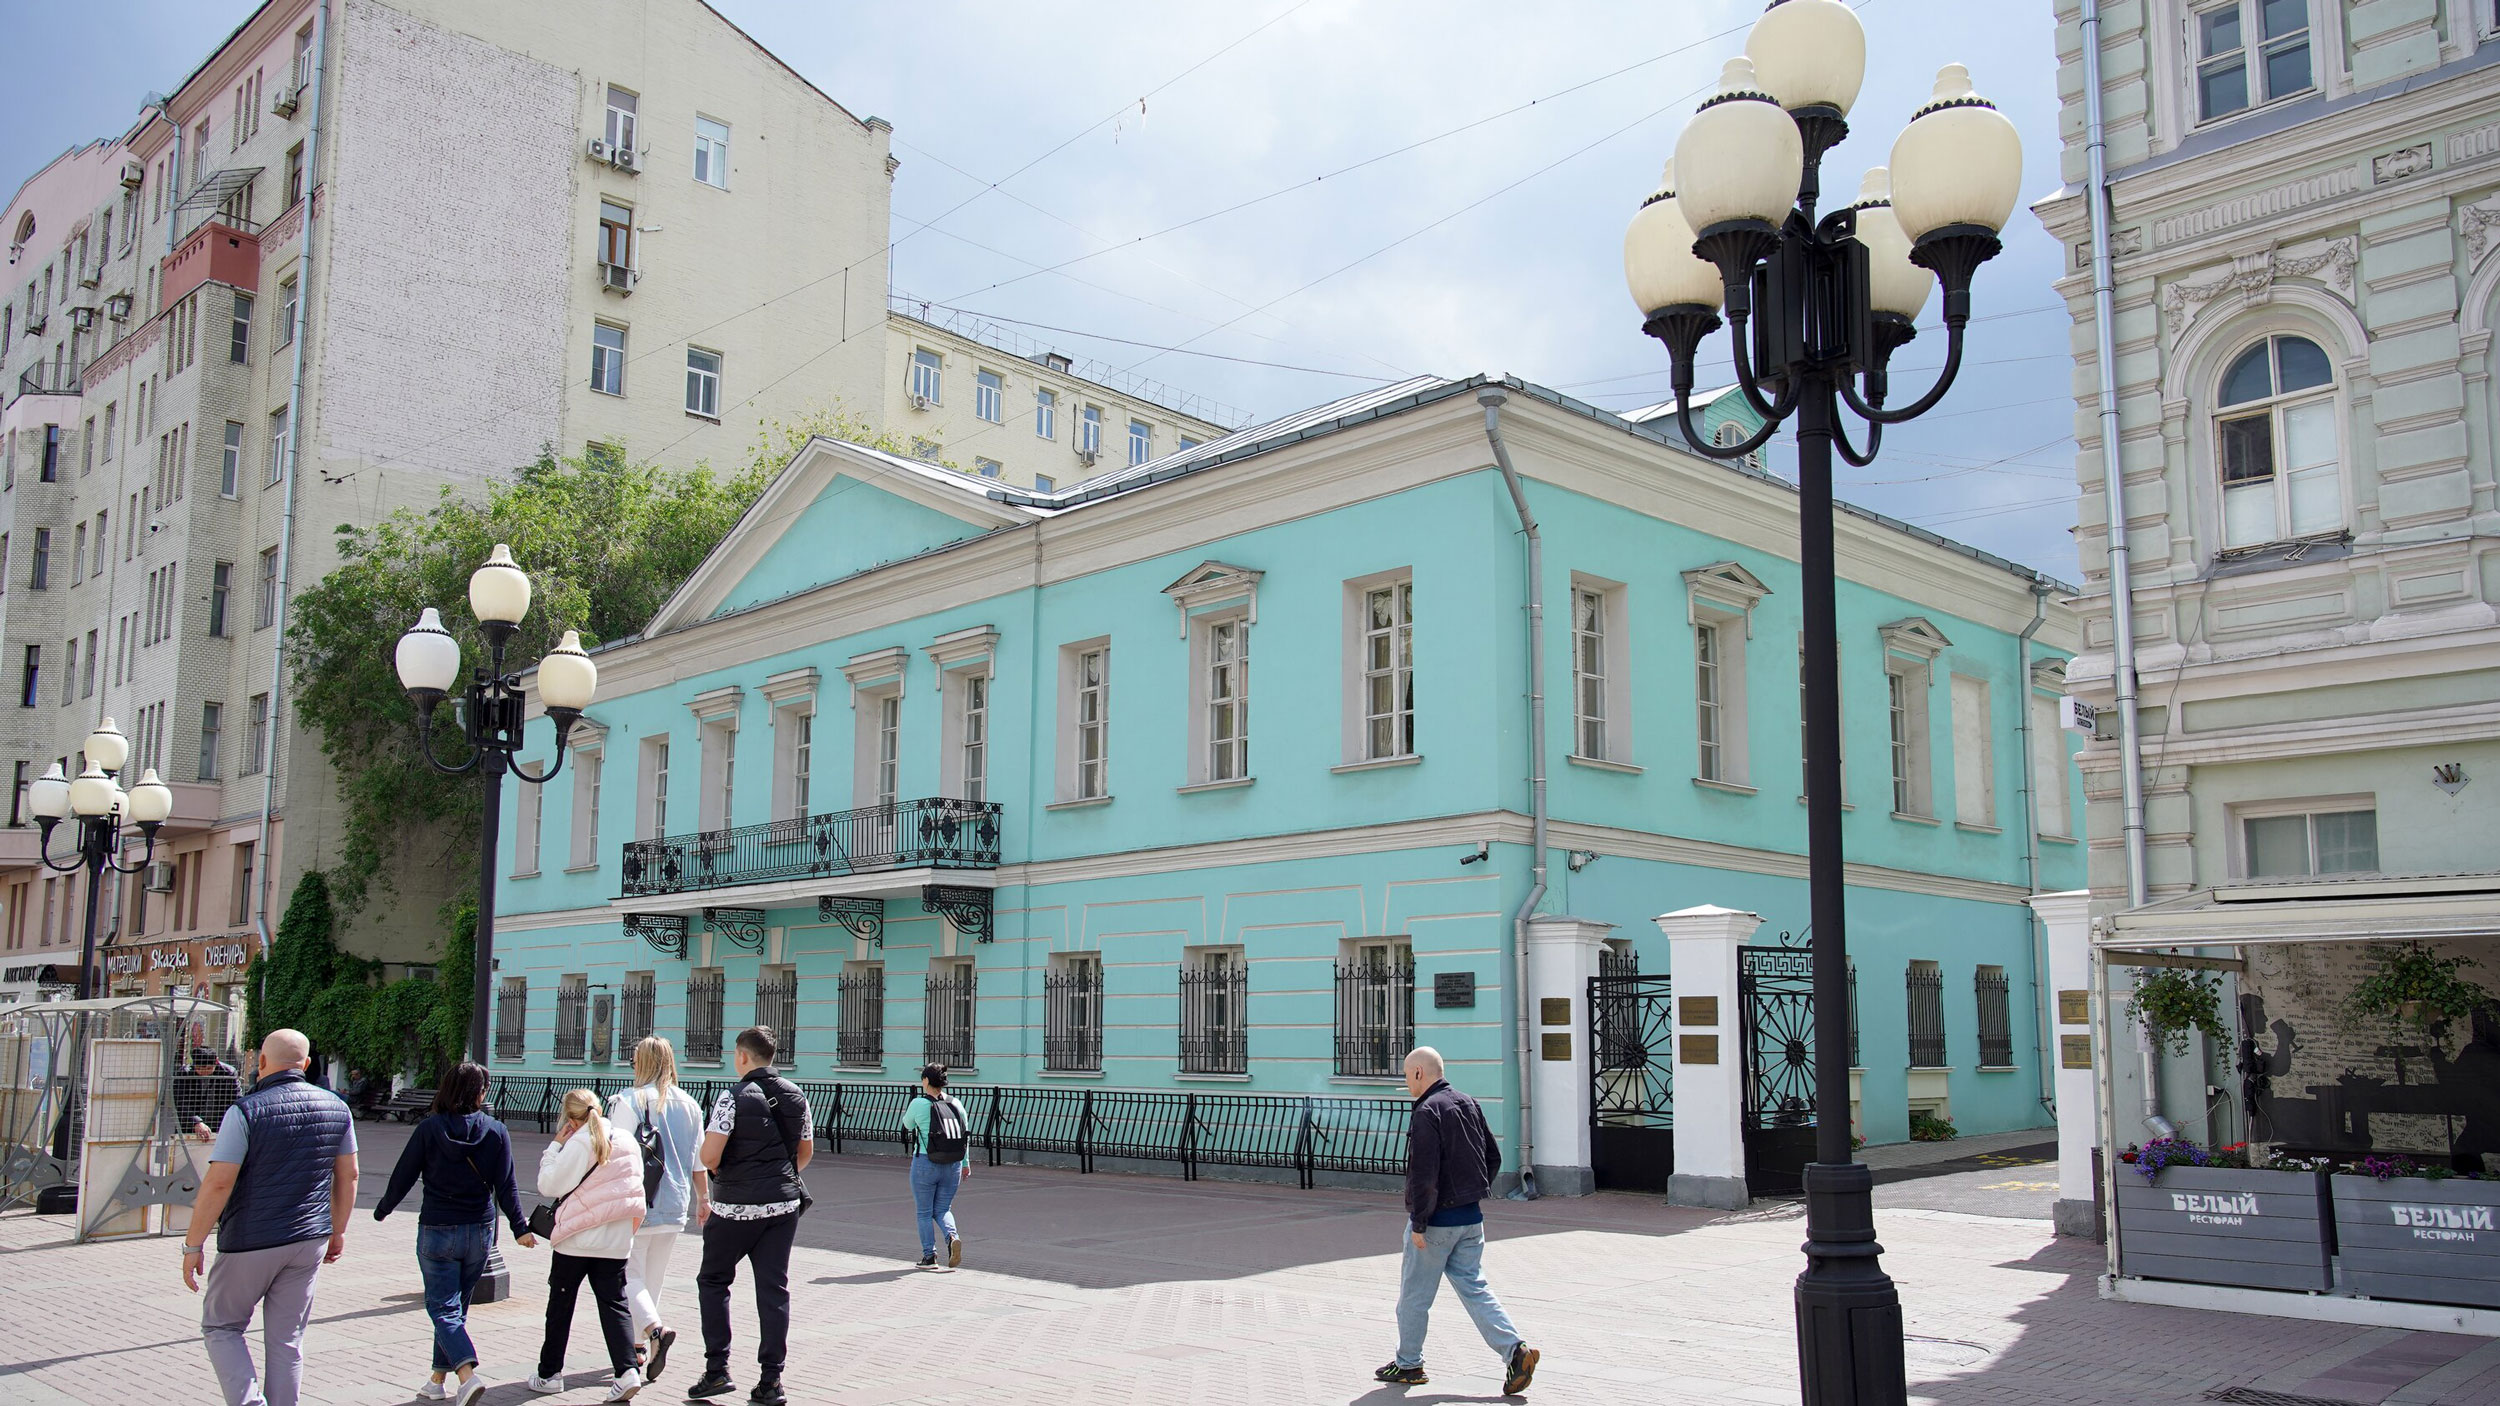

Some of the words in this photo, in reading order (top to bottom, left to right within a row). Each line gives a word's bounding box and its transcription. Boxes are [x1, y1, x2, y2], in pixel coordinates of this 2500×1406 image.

[107, 955, 142, 974] МАТРЕШКИ
[150, 947, 190, 972] Skazka
[204, 944, 247, 967] СУВЕНИРЫ
[2171, 1192, 2259, 1215] БЕЛЫЙ
[2189, 1214, 2242, 1226] РЕСТОРАН
[2391, 1206, 2494, 1230] БЕЛЫЙ
[2413, 1229, 2475, 1242] РЕСТОРАН
